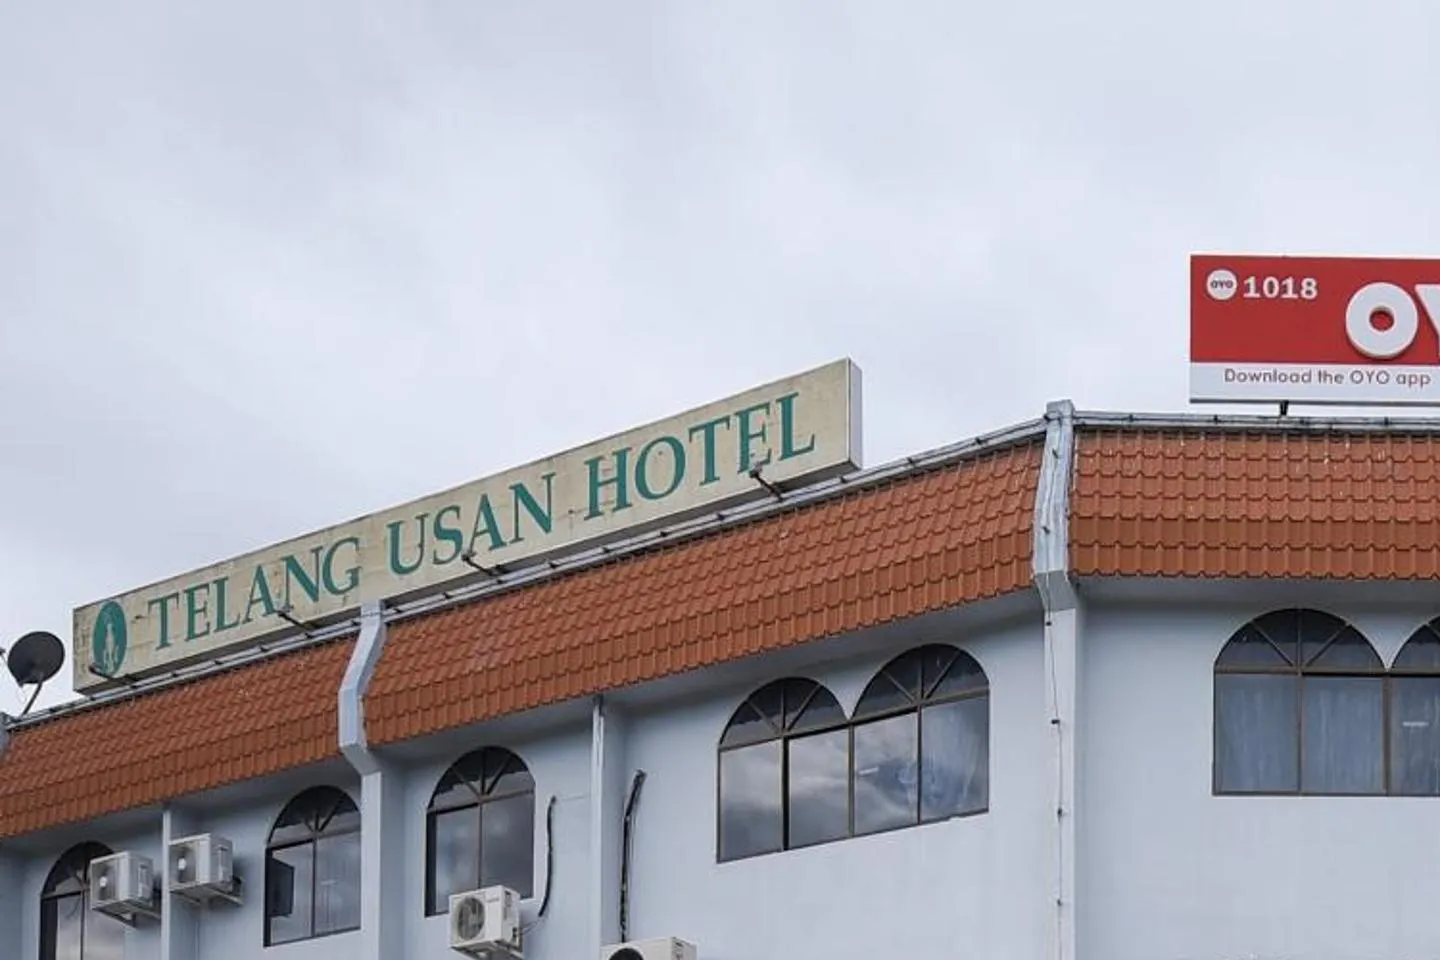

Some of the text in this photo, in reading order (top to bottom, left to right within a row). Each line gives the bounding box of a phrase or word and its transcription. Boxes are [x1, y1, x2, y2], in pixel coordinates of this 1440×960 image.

[1243, 276, 1318, 300] 1018
[1223, 368, 1431, 389] Download the OYO app
[147, 391, 817, 651] TELANG USAN HOTEL
